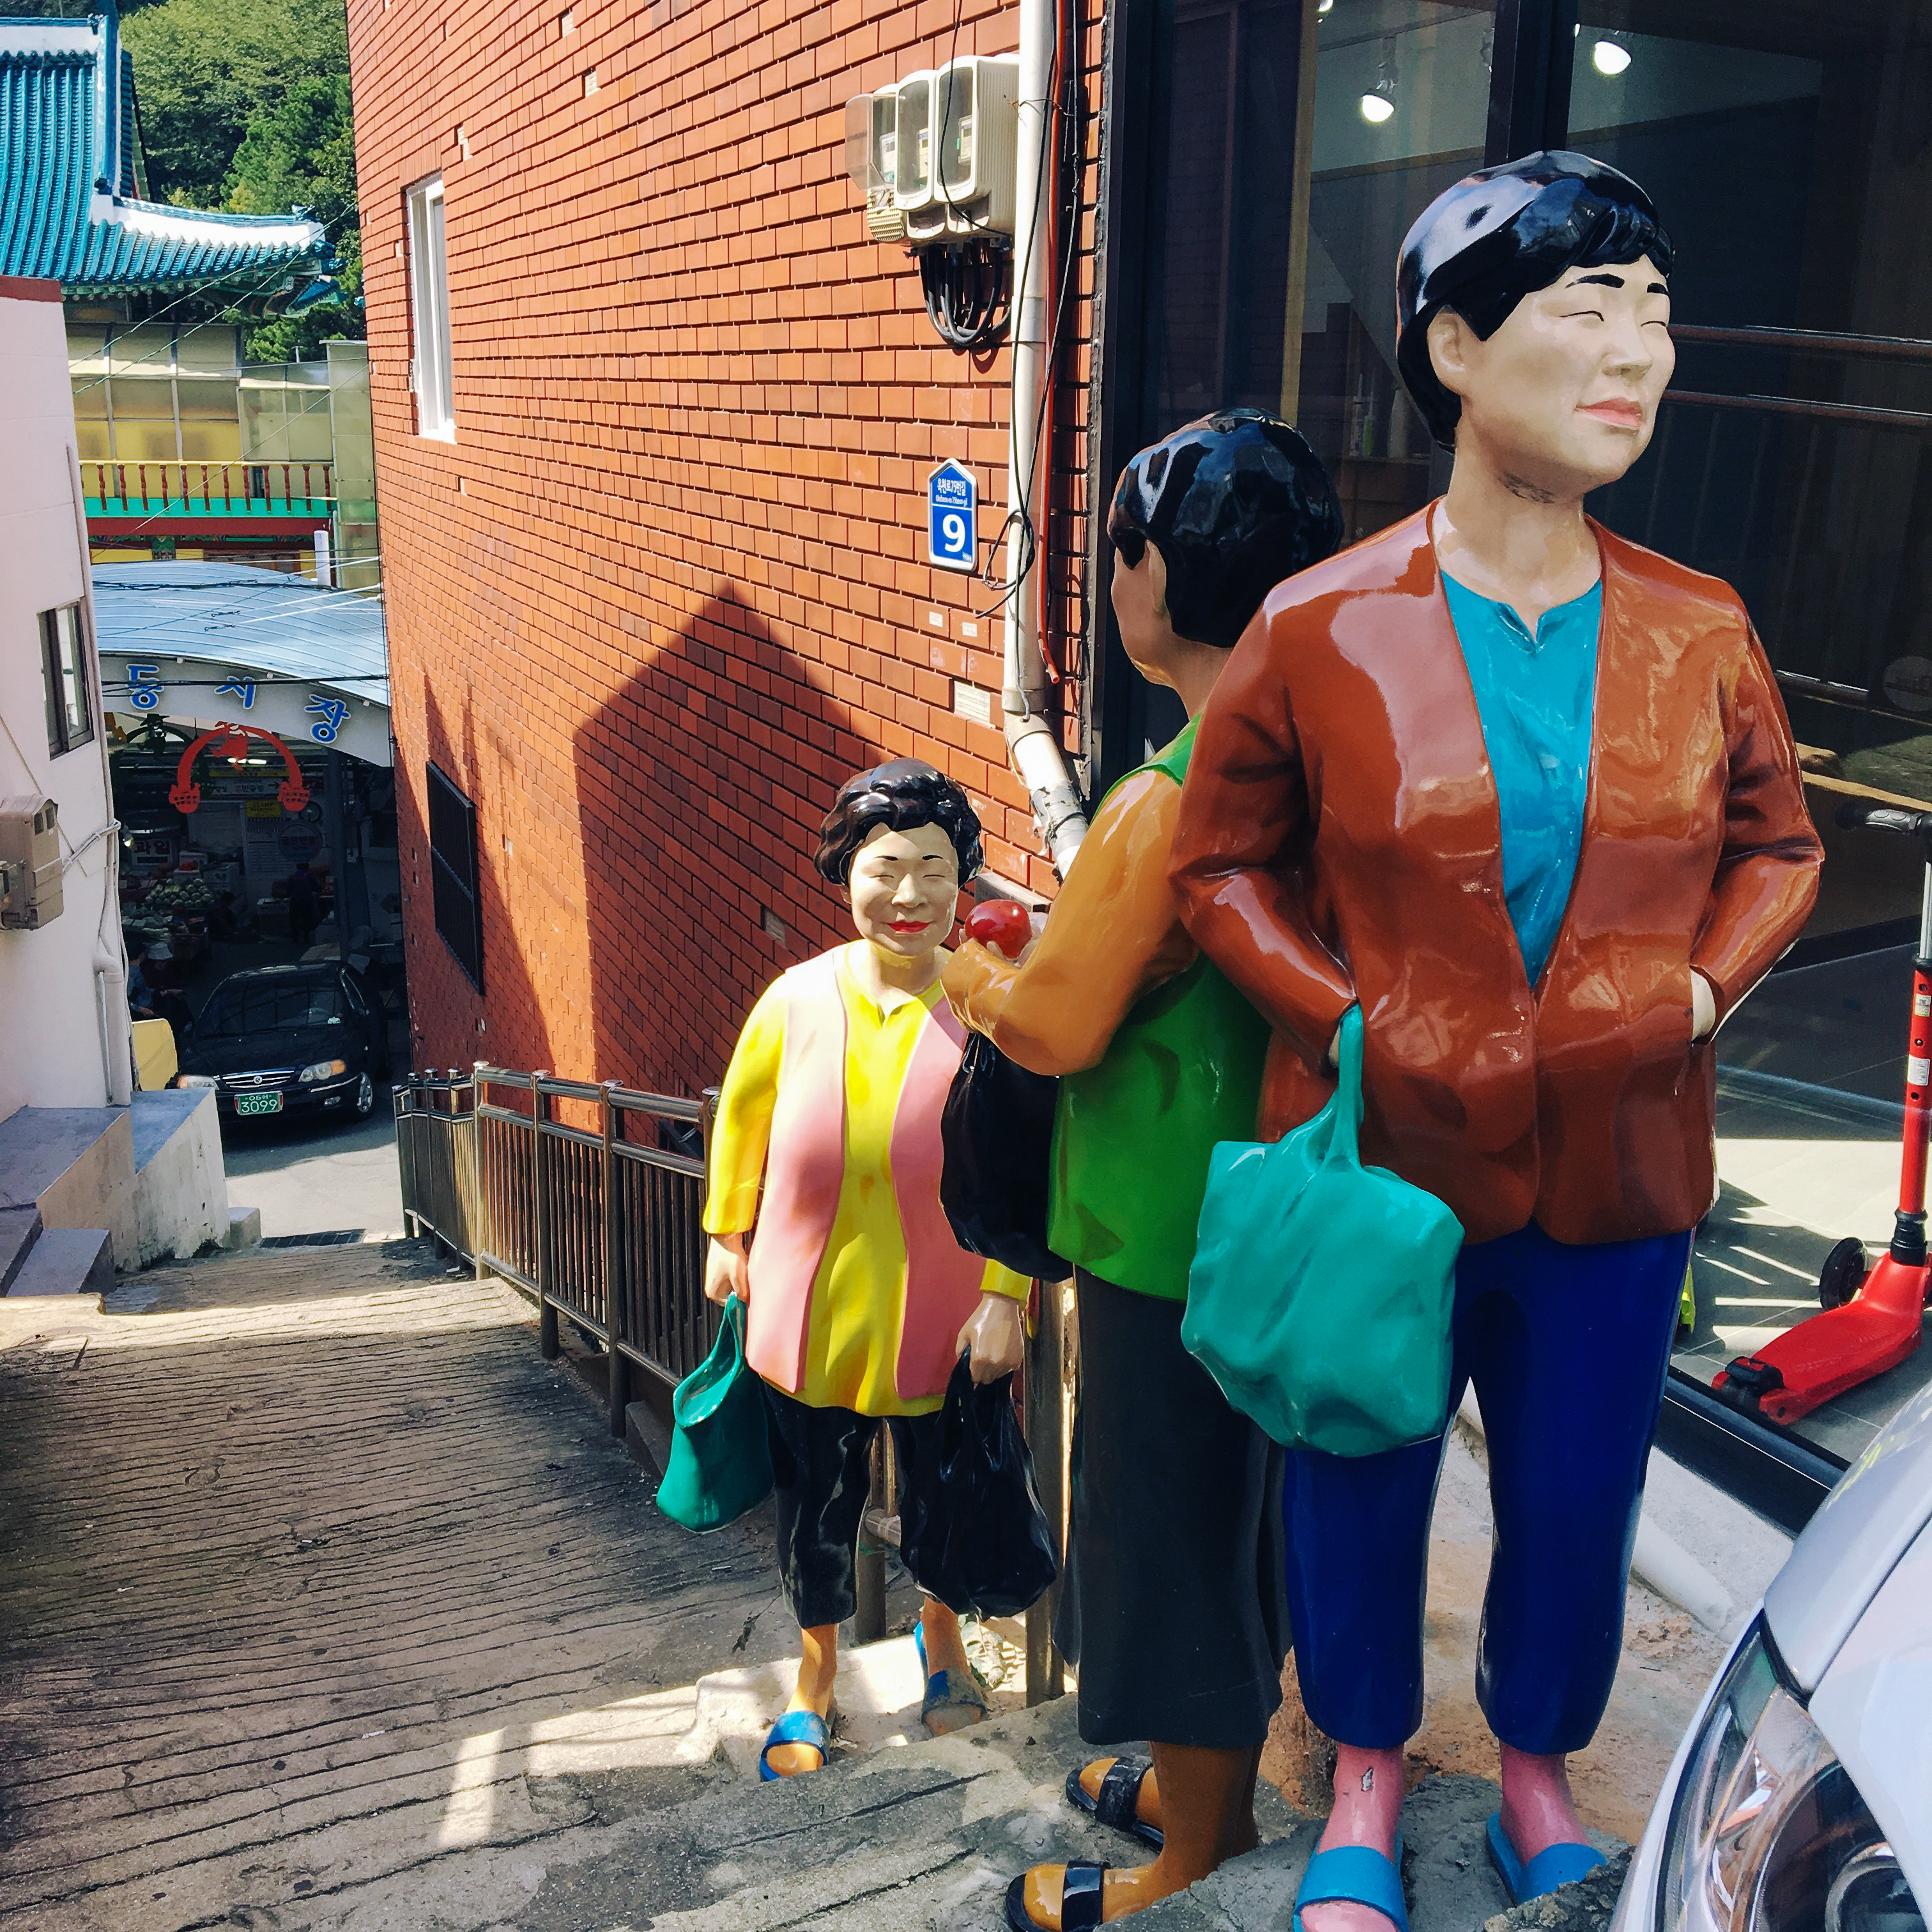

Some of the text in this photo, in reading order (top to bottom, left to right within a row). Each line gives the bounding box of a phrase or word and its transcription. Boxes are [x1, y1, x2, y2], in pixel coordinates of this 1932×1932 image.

[942, 514, 965, 552] 9
[134, 839, 171, 855] 과일
[241, 1099, 277, 1113] 3099
